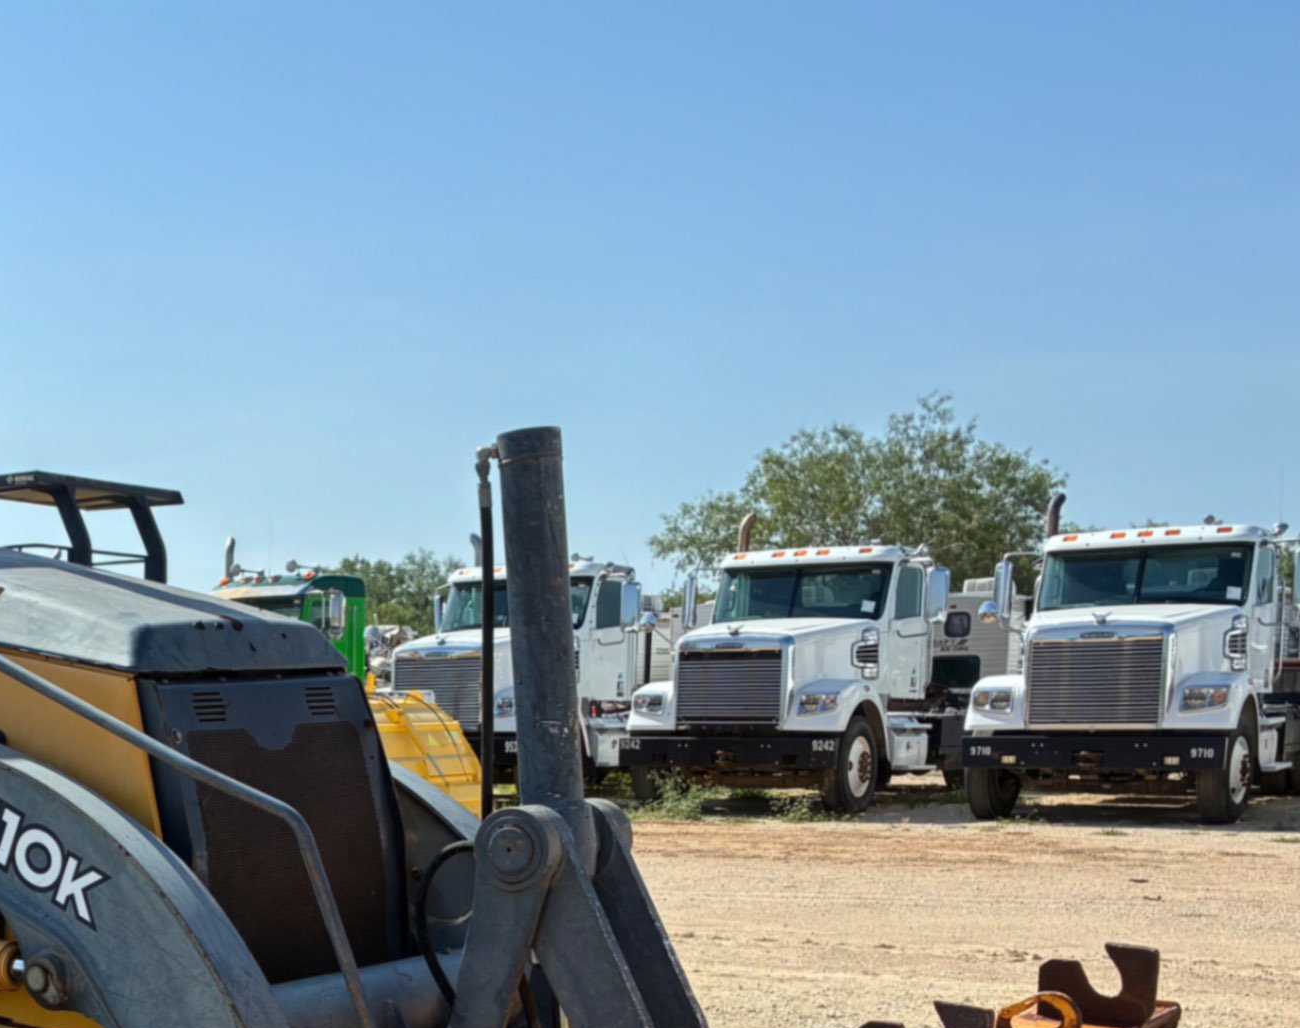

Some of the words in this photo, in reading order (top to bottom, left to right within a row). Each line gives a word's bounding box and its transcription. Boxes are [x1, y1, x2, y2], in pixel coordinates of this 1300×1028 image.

[812, 738, 835, 753] 9242
[969, 745, 992, 757] 9710
[1190, 747, 1215, 760] 9710
